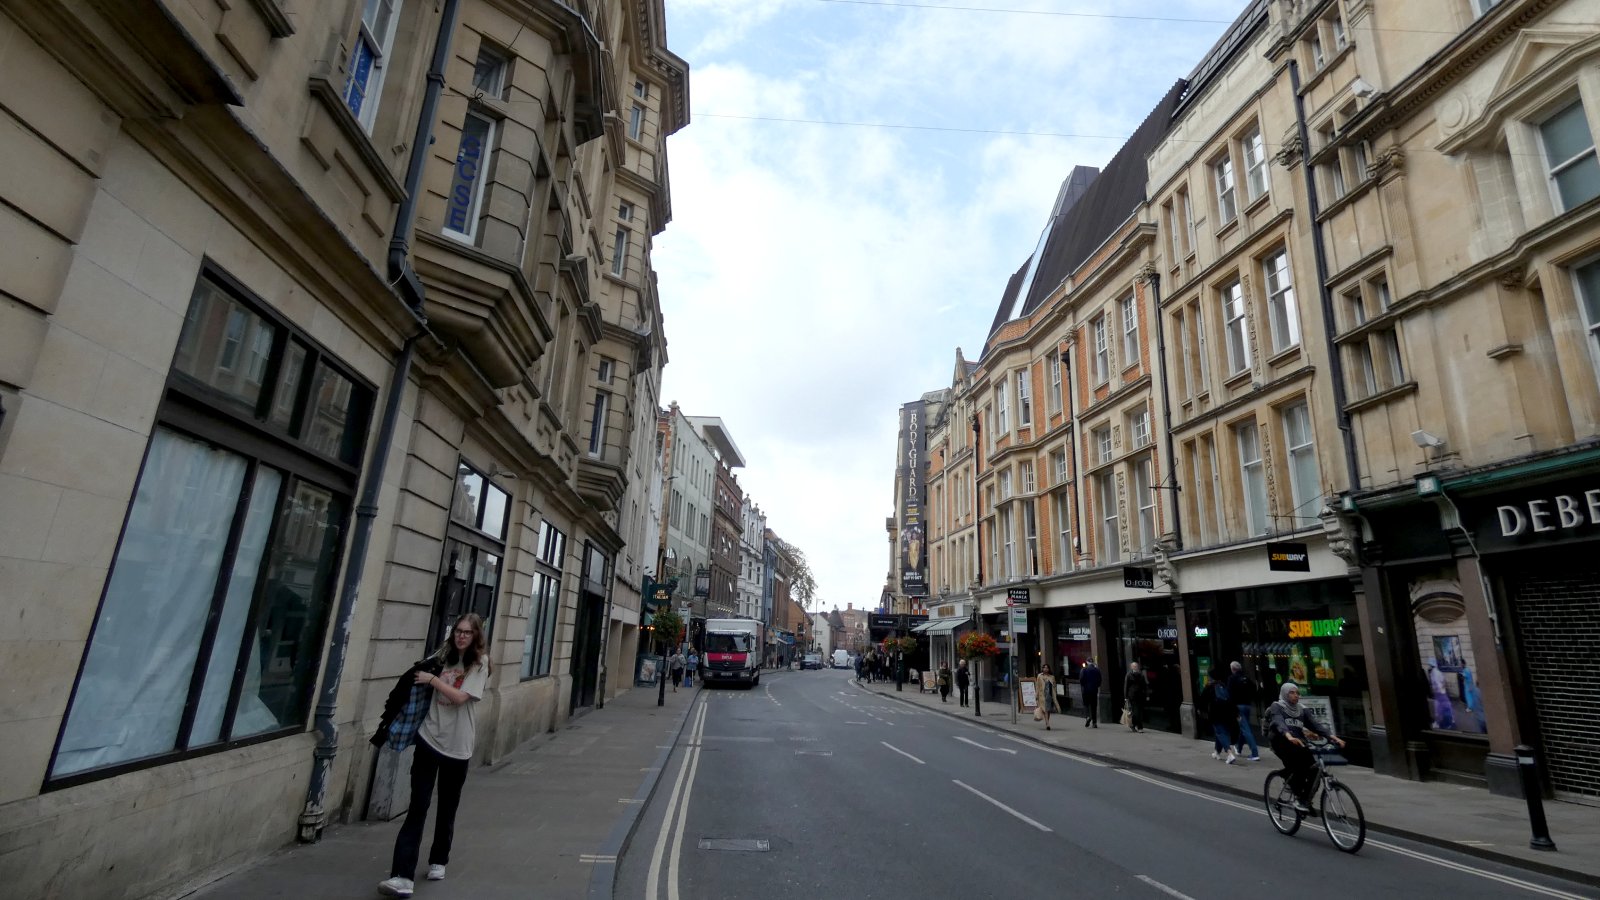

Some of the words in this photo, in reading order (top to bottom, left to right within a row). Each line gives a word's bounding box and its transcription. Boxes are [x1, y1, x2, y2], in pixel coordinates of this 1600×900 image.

[908, 413, 918, 496] BODYGUARD
[1271, 553, 1306, 562] SUBWAY
[1288, 617, 1342, 639] SUBWAY
